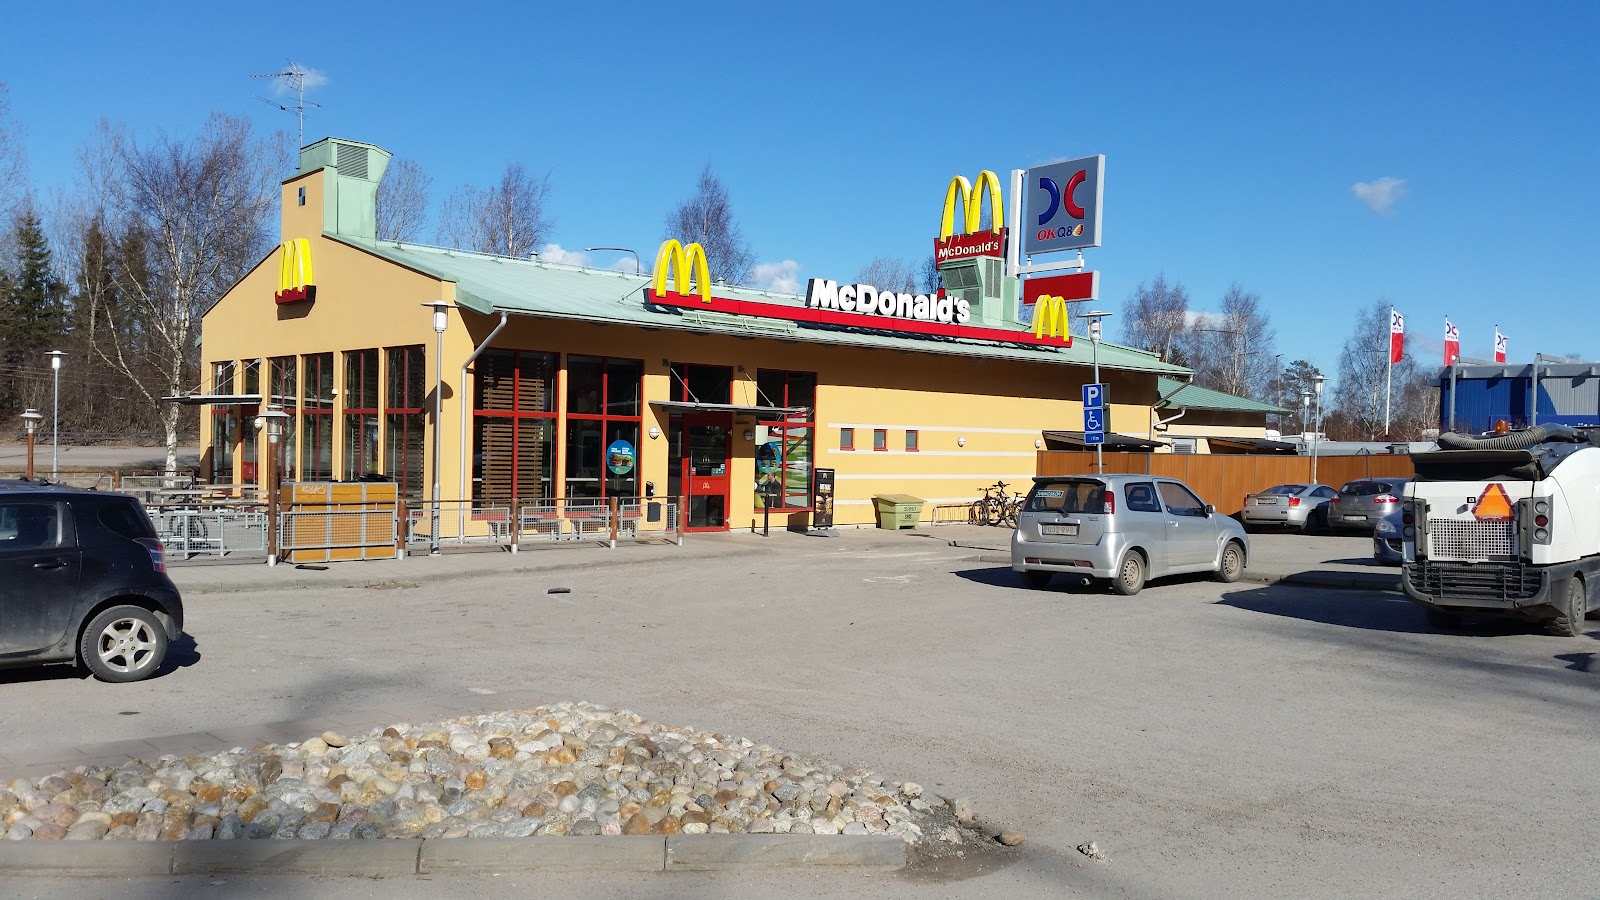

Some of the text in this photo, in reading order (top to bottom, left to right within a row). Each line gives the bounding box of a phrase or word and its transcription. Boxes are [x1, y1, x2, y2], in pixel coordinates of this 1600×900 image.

[937, 241, 999, 258] McDonald's
[808, 278, 971, 323] McDonald's
[1087, 386, 1099, 406] P
